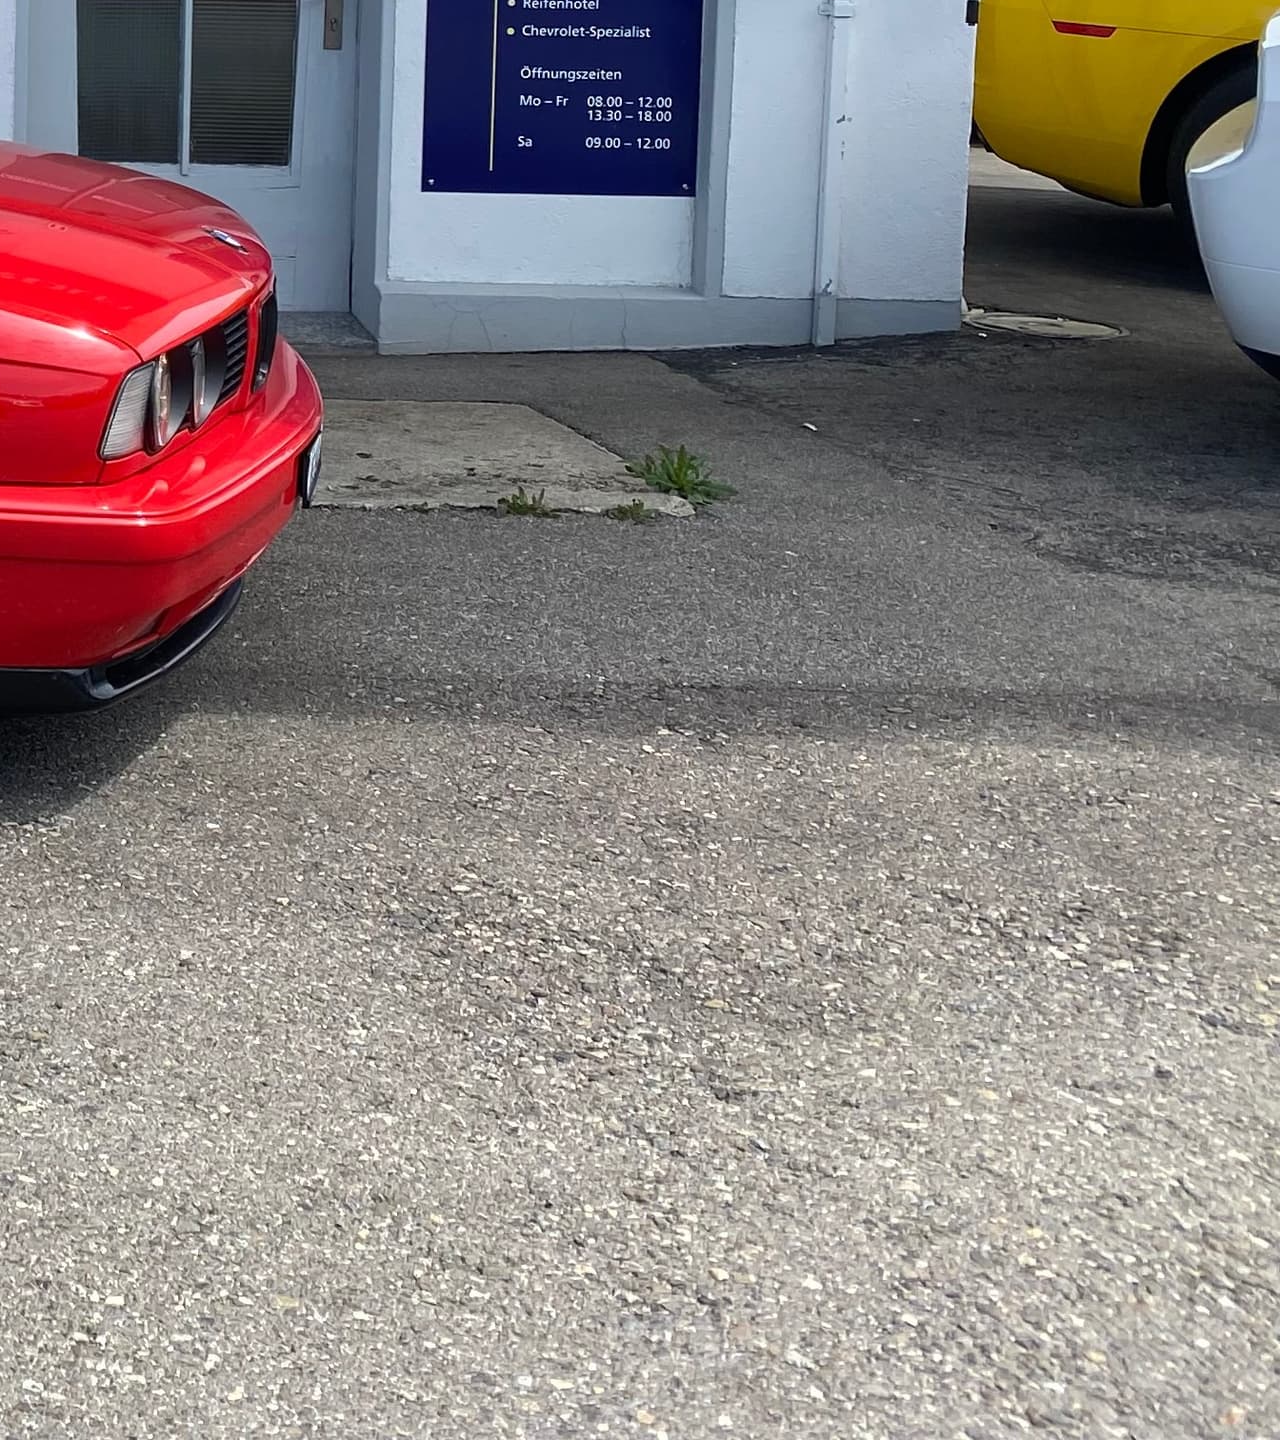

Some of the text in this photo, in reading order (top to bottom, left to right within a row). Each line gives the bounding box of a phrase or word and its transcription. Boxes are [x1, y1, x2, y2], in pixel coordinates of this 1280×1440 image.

[521, 25, 651, 41] Chevrolet-Spezialist
[520, 64, 622, 82] Öffnungszeiten
[519, 95, 541, 107] Mo
[555, 95, 569, 107] Fr
[587, 96, 622, 108] 08.00
[638, 96, 672, 109] 12.00
[587, 110, 622, 122] 13.30
[637, 110, 672, 123] 18.00
[517, 136, 533, 148] Sa
[585, 137, 621, 149] 09.00
[636, 137, 671, 150] 12.00
